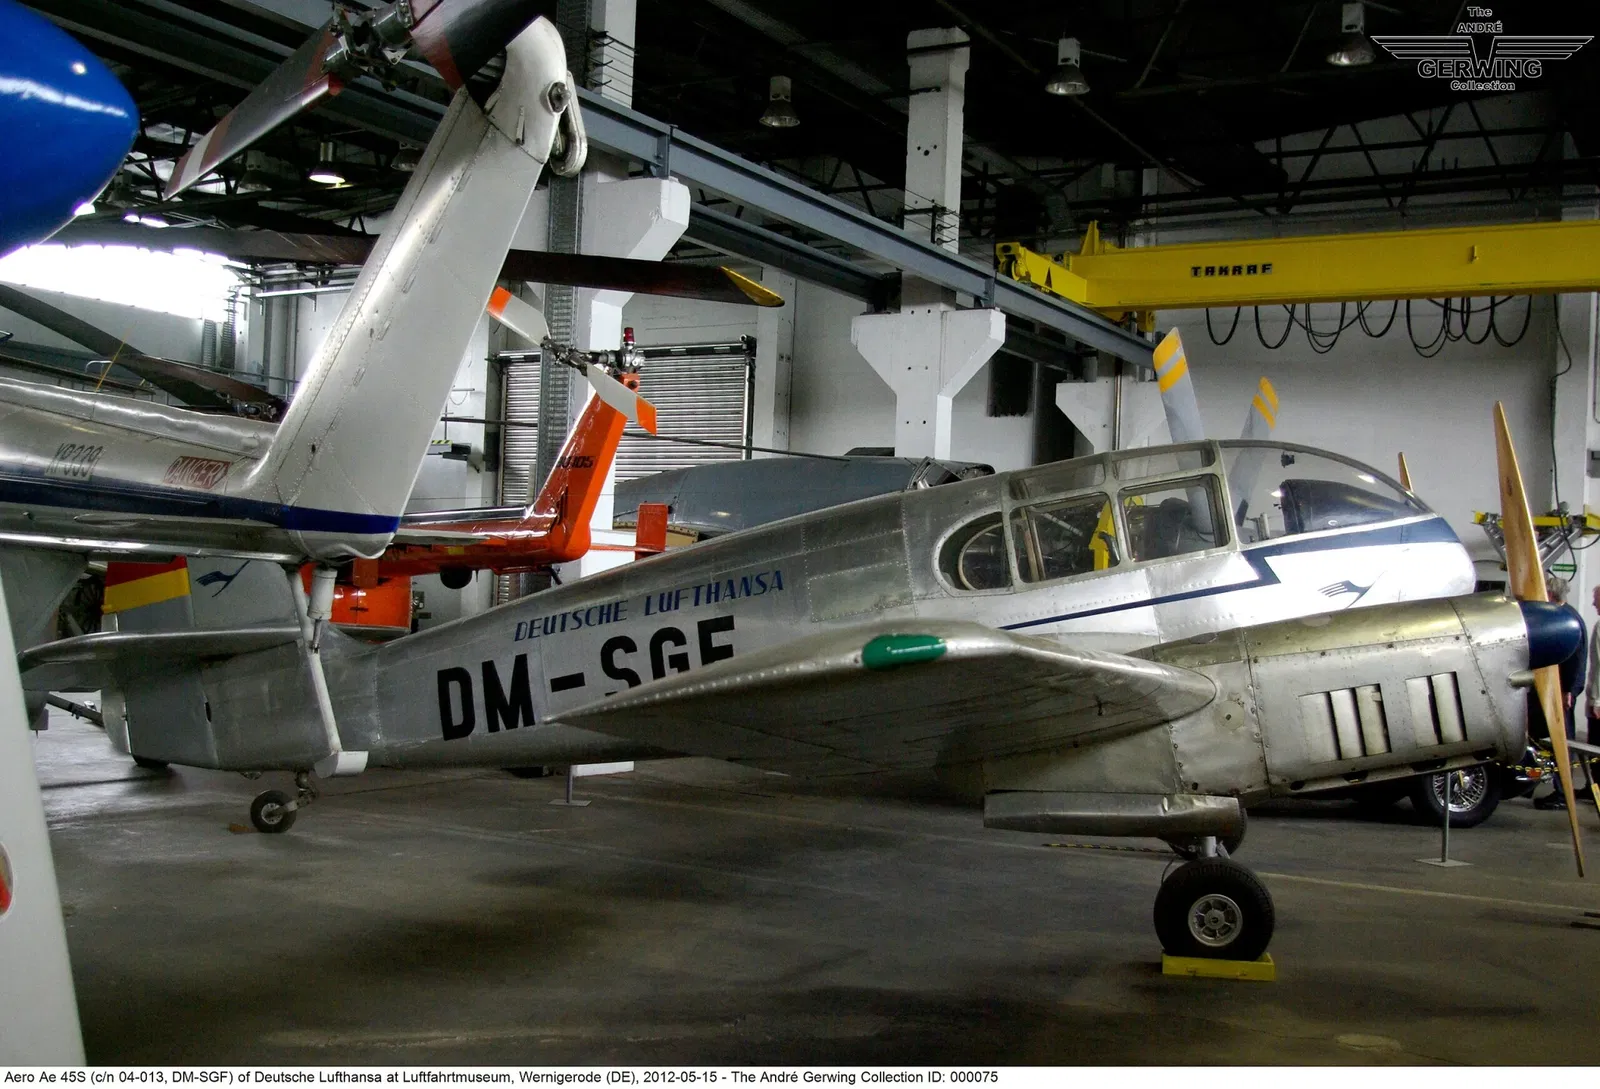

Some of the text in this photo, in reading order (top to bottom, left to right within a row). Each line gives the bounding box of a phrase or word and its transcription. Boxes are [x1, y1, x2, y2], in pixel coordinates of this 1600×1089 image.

[1191, 263, 1273, 278] TAKRAF
[163, 456, 225, 488] DANGER
[513, 570, 785, 642] DEUTSCHE LUFTHANSA
